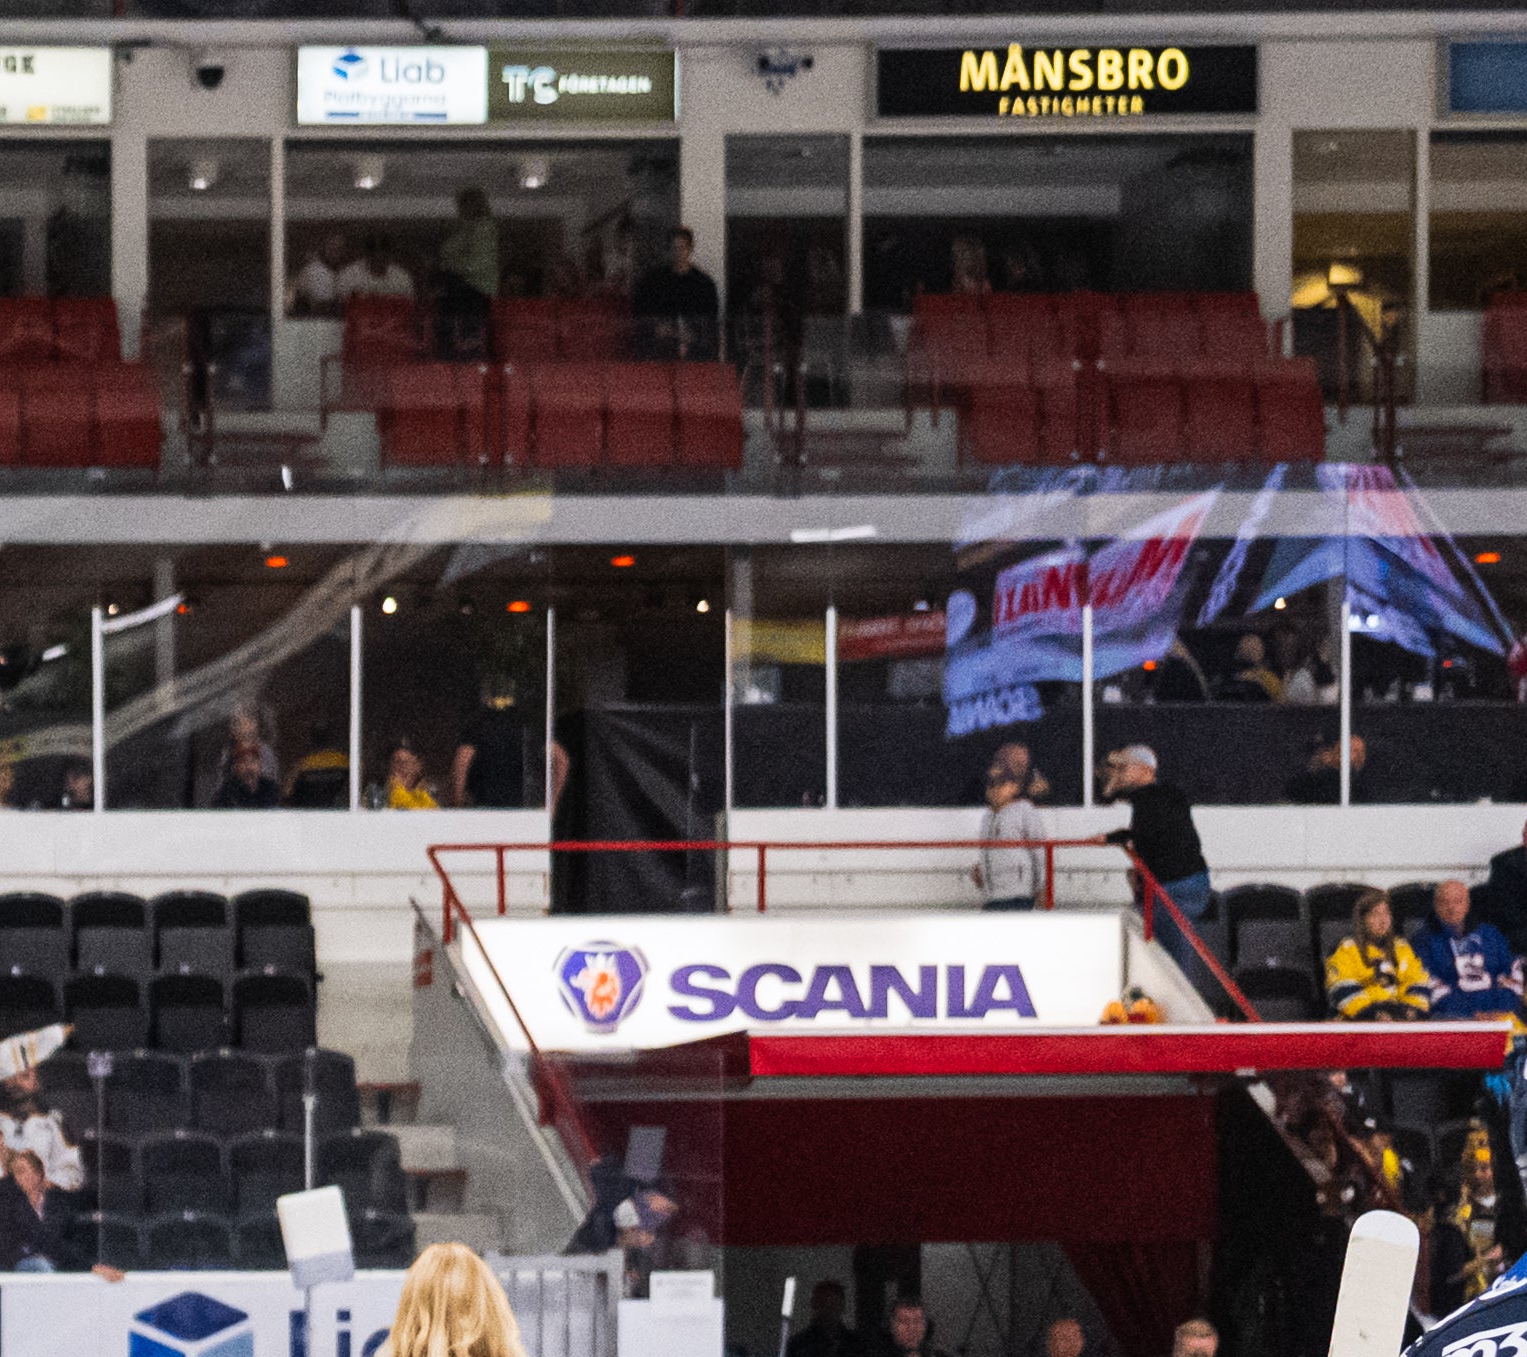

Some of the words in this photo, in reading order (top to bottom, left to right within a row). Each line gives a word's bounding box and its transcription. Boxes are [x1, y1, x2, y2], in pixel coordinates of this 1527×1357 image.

[380, 56, 446, 84] Liab
[959, 43, 1190, 92] MÅNSBRO
[998, 95, 1146, 117] FASTIGHETER
[666, 962, 1039, 1022] SCANIA
